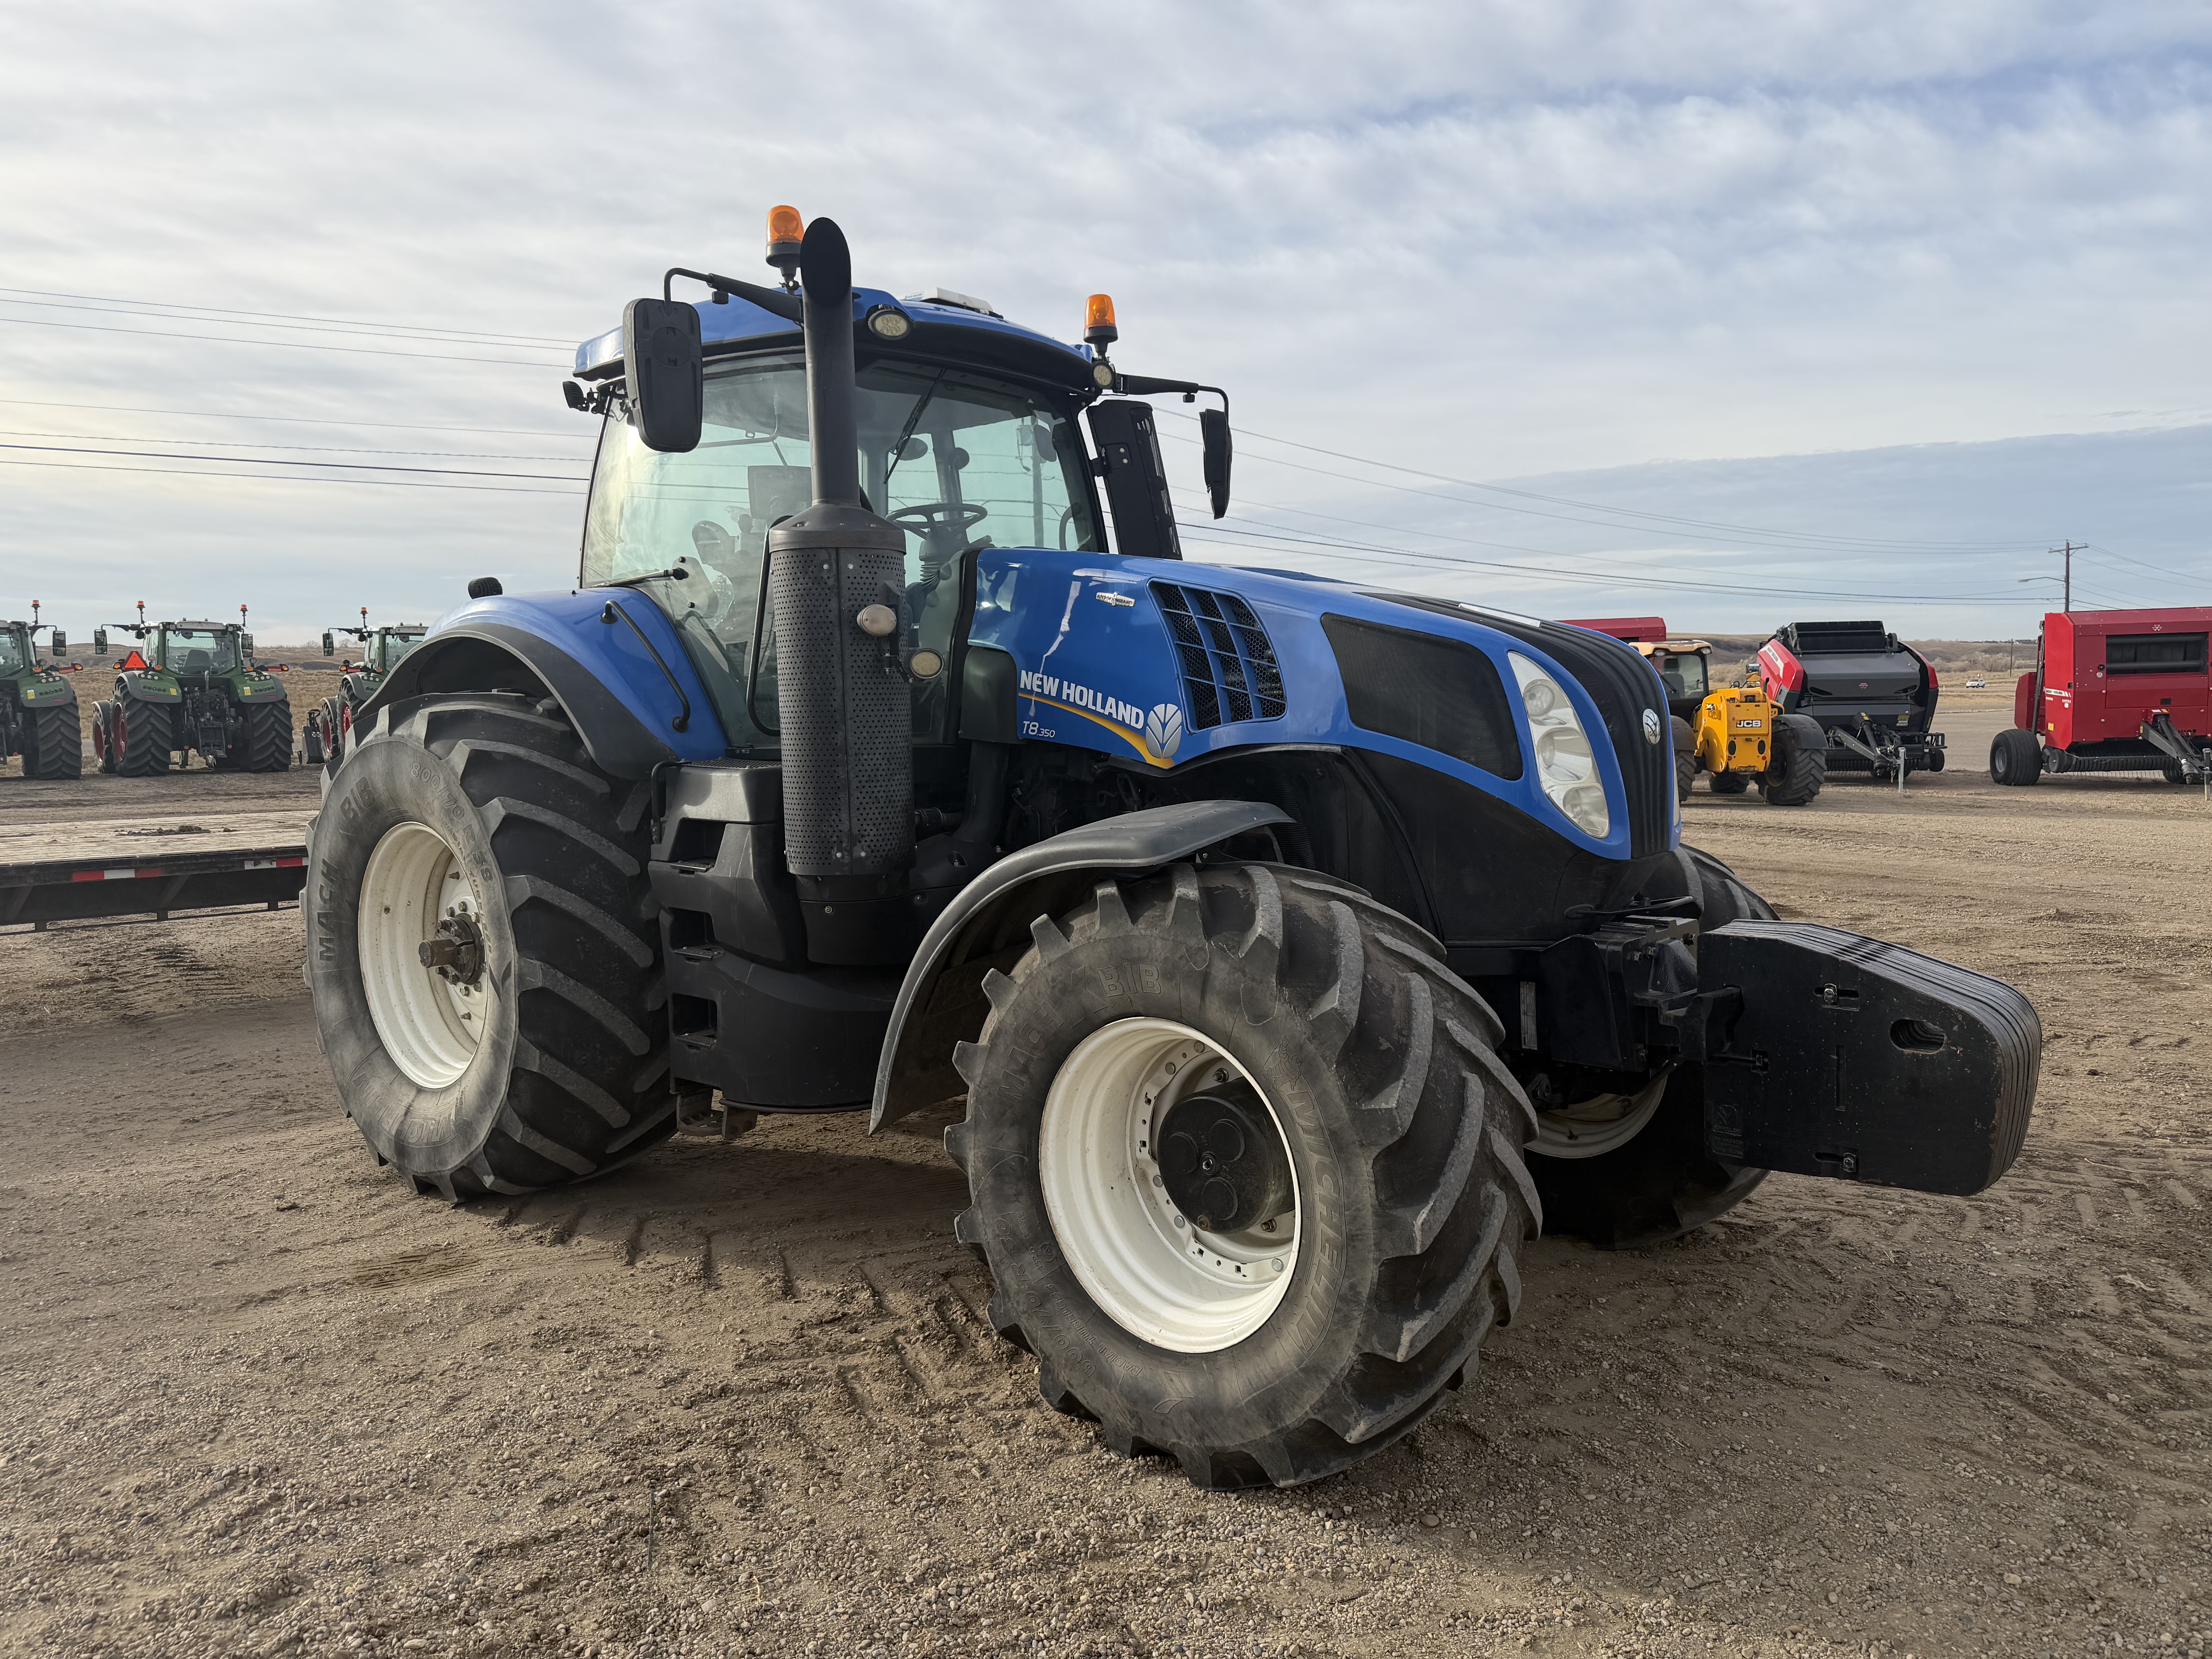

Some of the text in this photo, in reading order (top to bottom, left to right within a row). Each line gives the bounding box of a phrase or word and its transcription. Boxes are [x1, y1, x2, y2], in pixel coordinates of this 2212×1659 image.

[1020, 670, 1144, 729] NEW HOLLAND
[1023, 721, 1056, 738] T8.350
[410, 761, 465, 820] 800/70
[463, 824, 476, 845] R
[317, 776, 374, 962] MACH BIB
[998, 1001, 1064, 1107] MACH
[1097, 963, 1161, 998] BIB
[353, 1073, 453, 1144] MICHELIN
[995, 1218, 1018, 1254] 30
[1287, 1091, 1343, 1352] MICHELIN
[1011, 1262, 1030, 1282] R
[1024, 1291, 1096, 1378] 600/70
[1045, 1283, 1143, 1376] RADIAL TUBELESS
